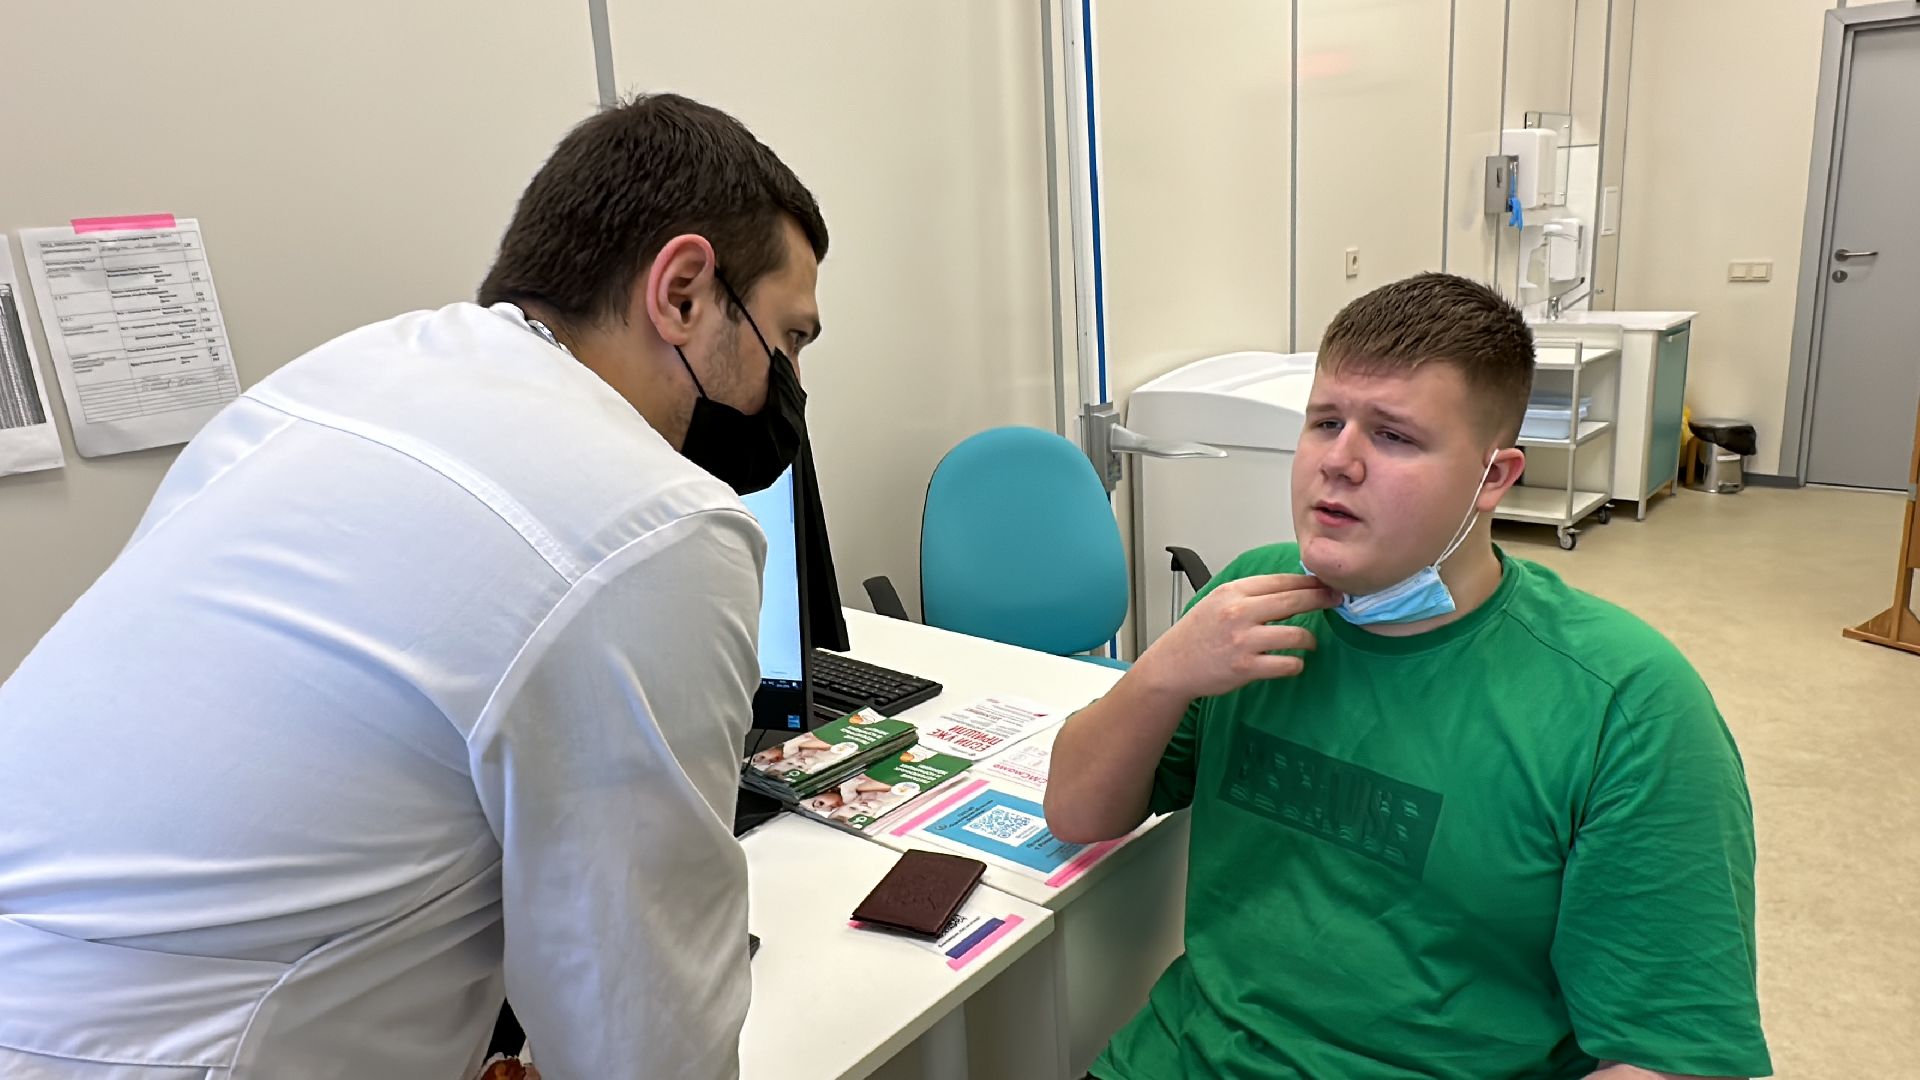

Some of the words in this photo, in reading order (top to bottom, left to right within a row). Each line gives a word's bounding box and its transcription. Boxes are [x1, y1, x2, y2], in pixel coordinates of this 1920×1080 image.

[926, 729, 958, 742] УЖЕ
[948, 725, 1004, 745] ПРИШЛИ
[954, 738, 991, 752] ЕСЛИ
